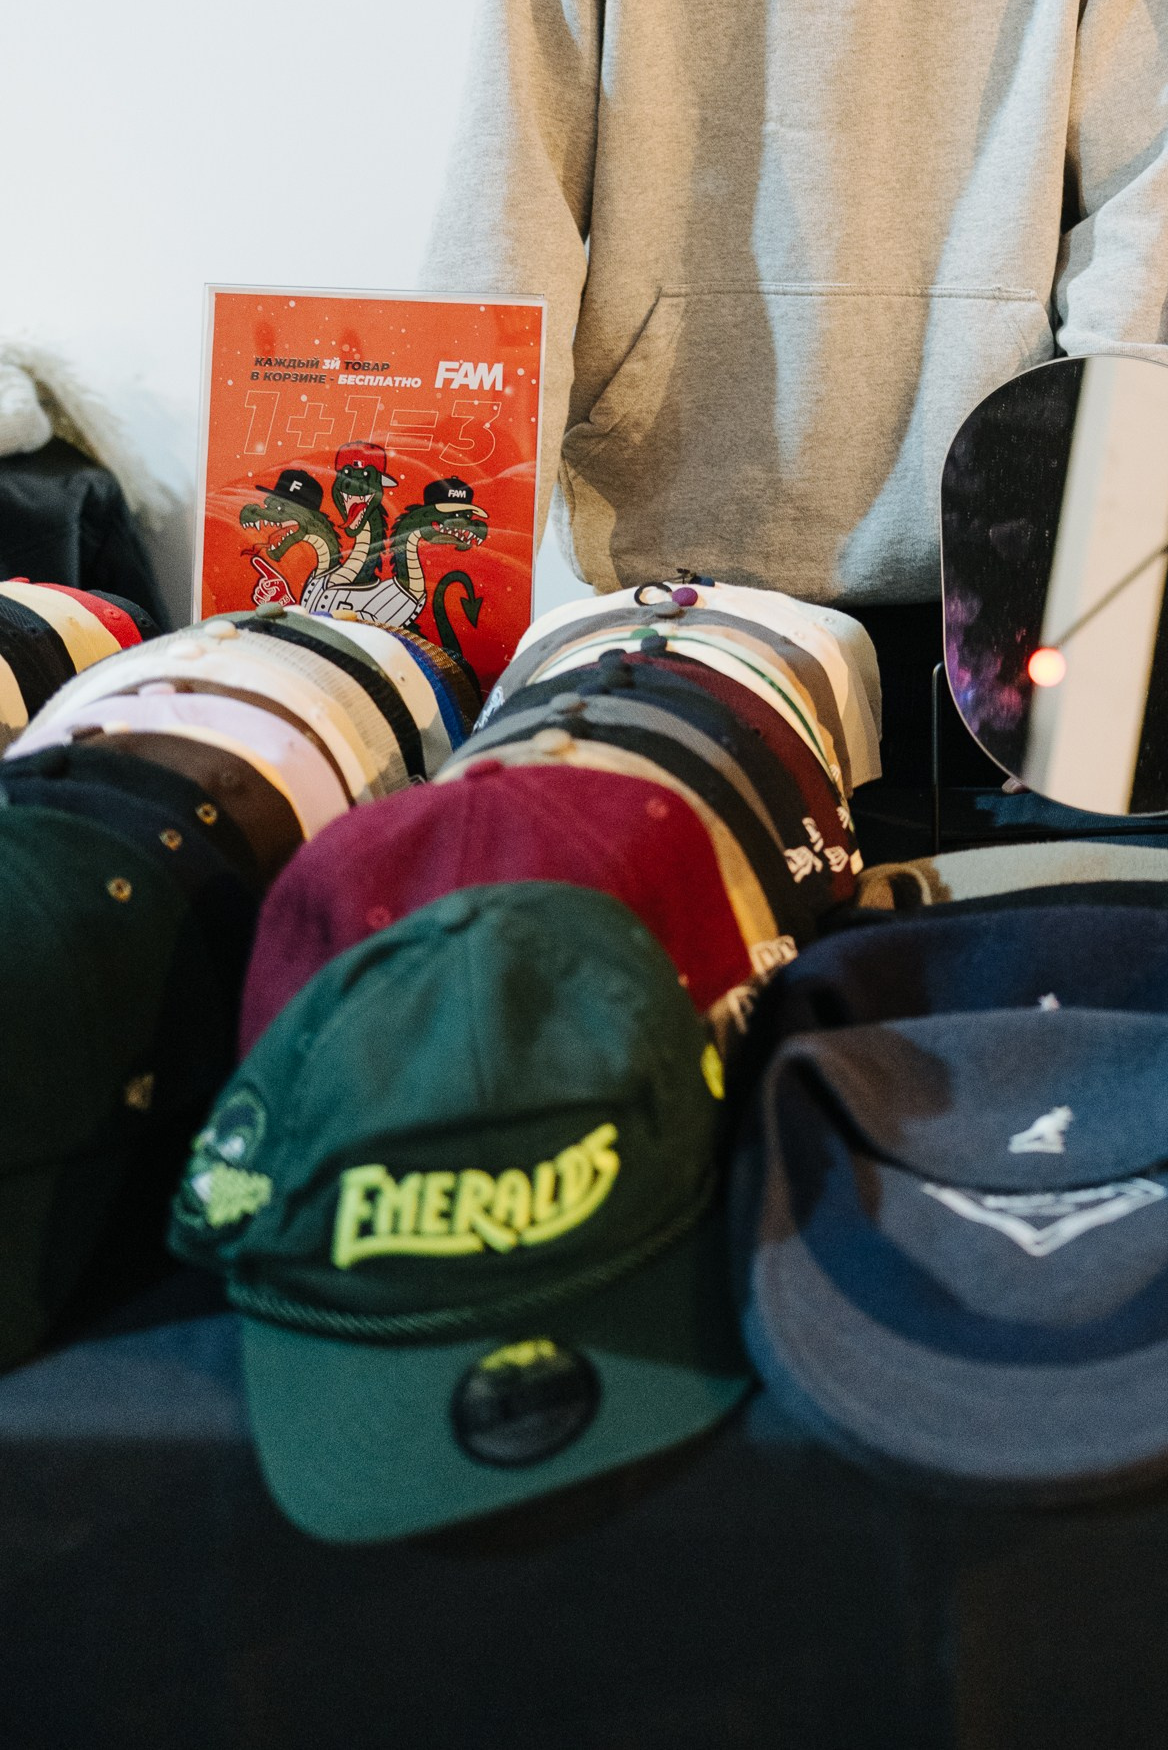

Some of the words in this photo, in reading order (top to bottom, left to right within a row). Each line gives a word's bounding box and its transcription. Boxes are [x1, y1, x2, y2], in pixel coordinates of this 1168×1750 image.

[254, 356, 320, 370] КАЖДЫЙ
[344, 360, 390, 372] ТОВАР
[250, 371, 260, 381] В
[263, 371, 327, 384] КОРЗИНЕ
[337, 374, 422, 388] БЕСПЛАТНО
[434, 361, 504, 391] FAM
[244, 390, 502, 467] 1+1=3
[289, 480, 303, 493] F
[448, 488, 467, 499] FAM
[333, 1123, 620, 1269] EMERALDS
